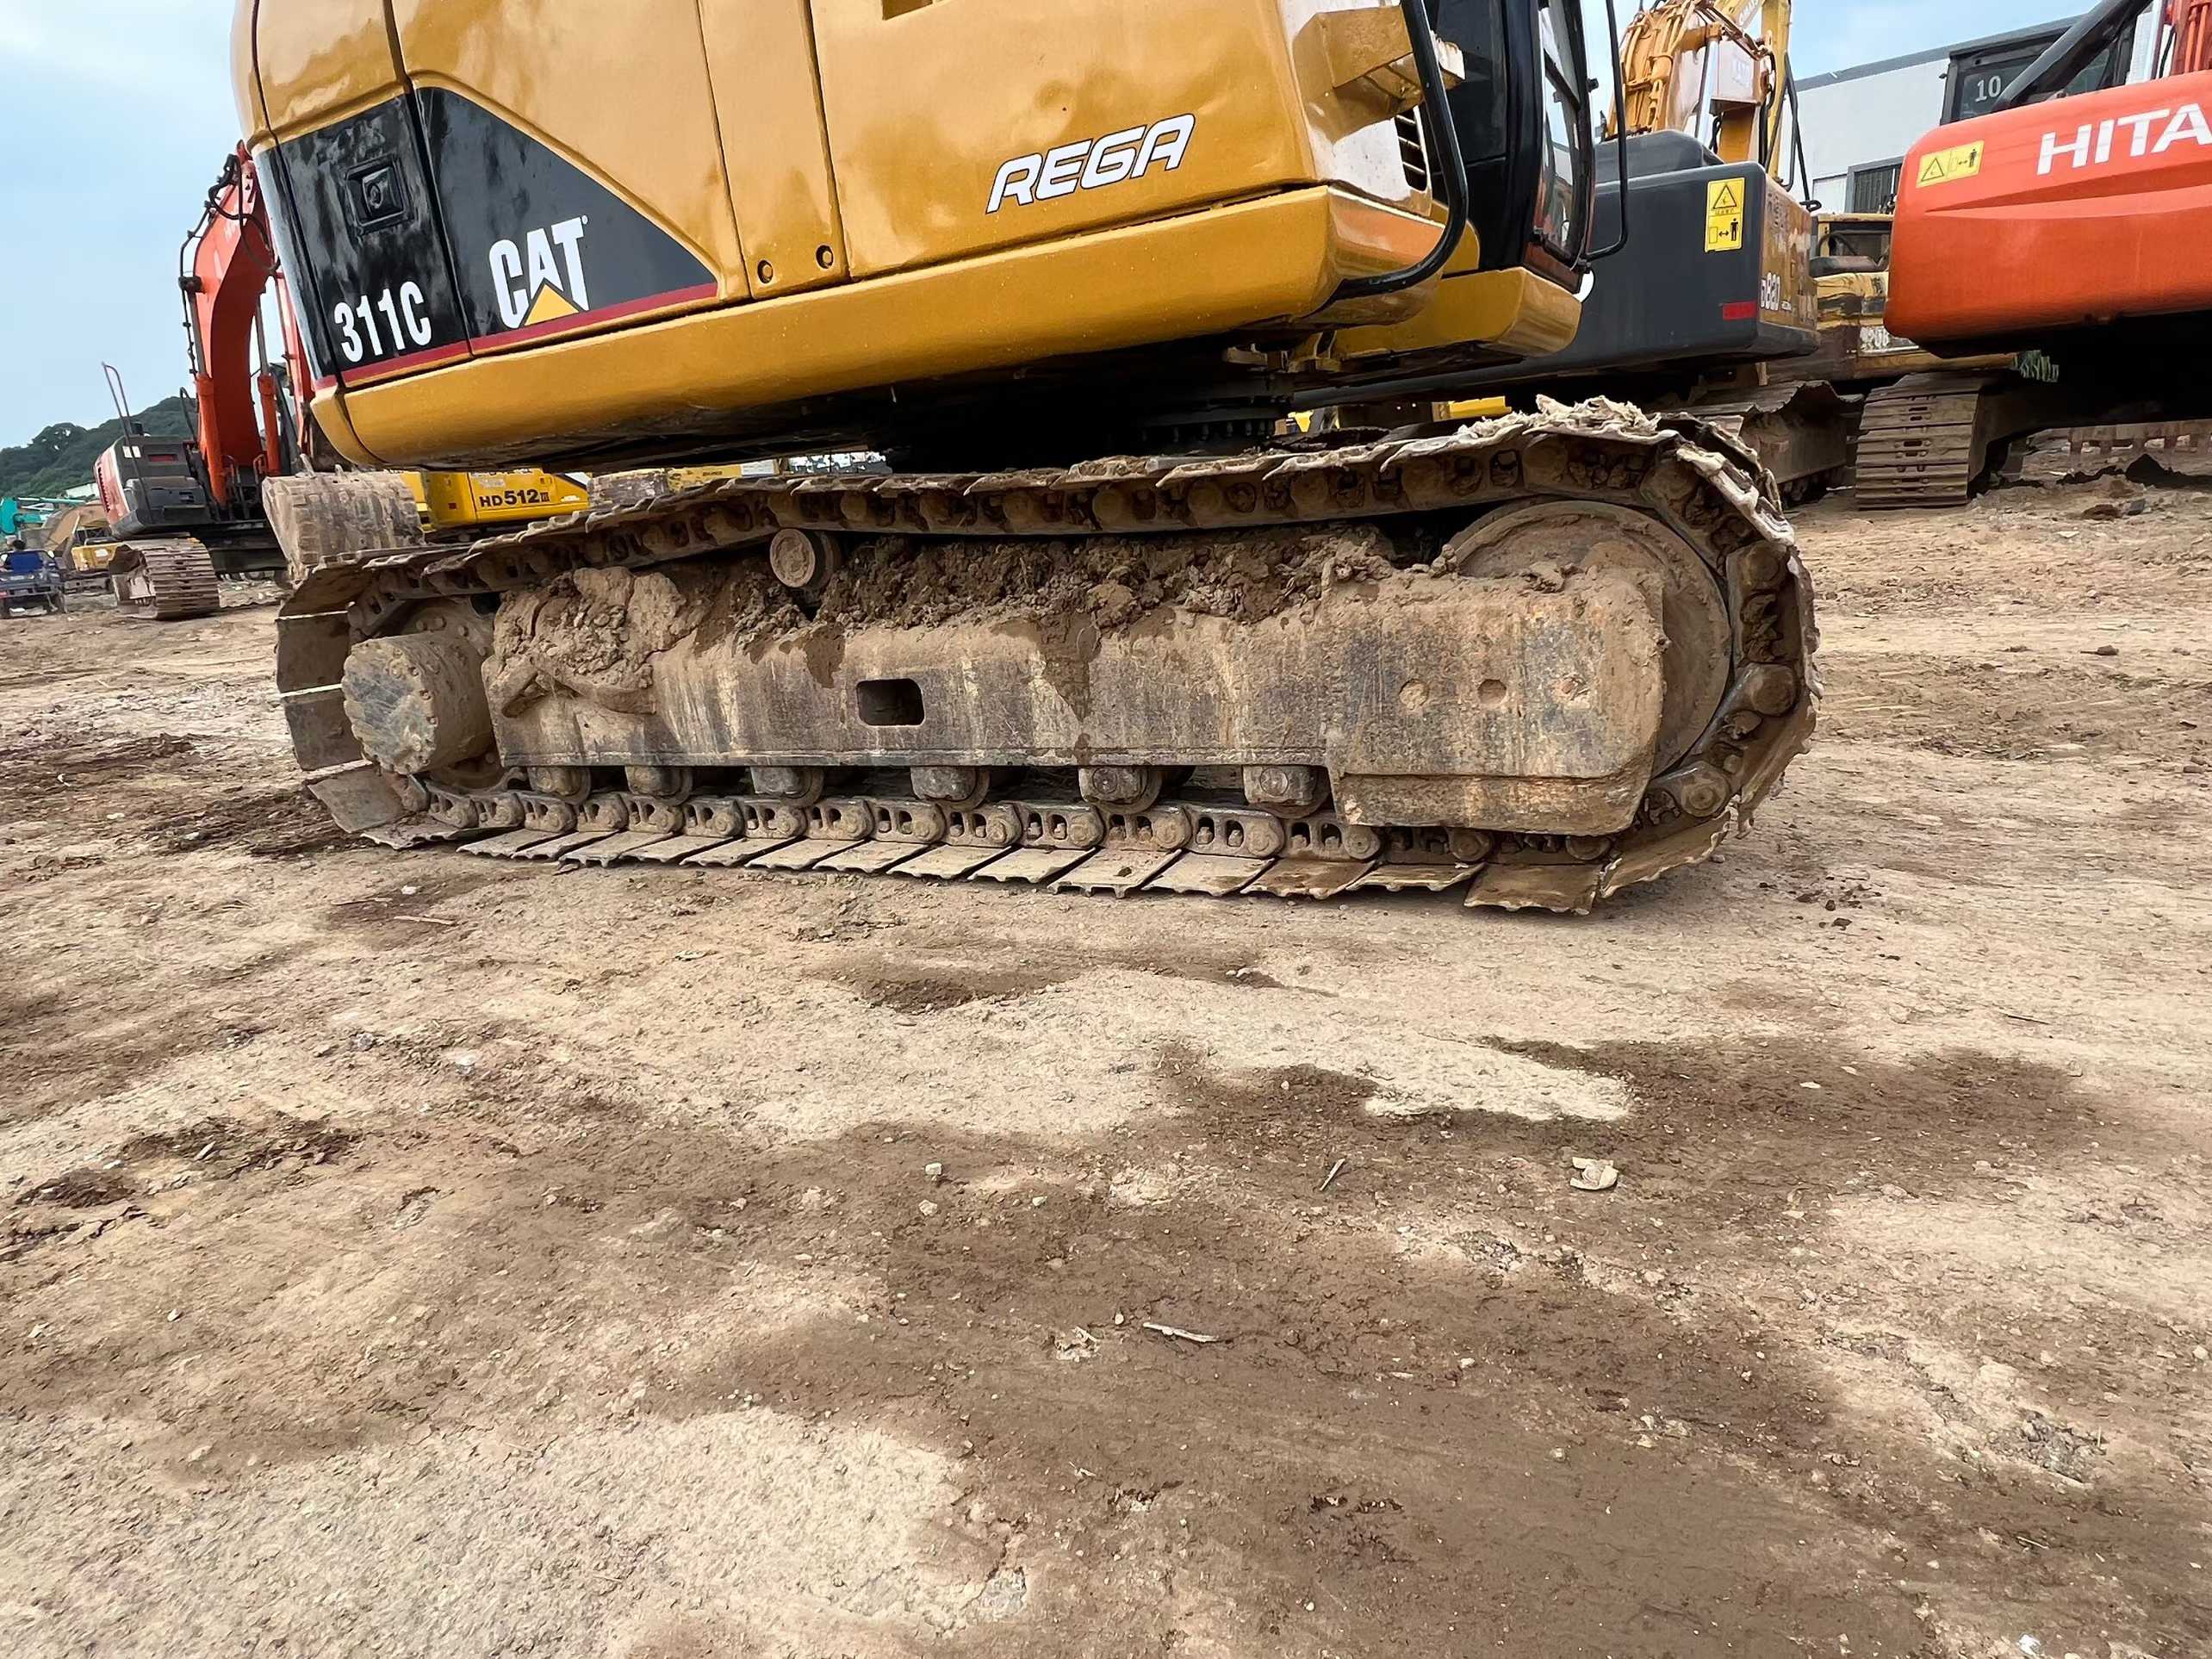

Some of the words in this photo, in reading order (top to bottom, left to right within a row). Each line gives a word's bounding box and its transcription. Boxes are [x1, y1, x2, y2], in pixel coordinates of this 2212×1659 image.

[1975, 76, 2002, 103] 10
[985, 109, 1196, 214] REGA
[2037, 103, 2212, 176] HITA
[489, 215, 590, 329] CAT
[334, 281, 432, 363] 311C
